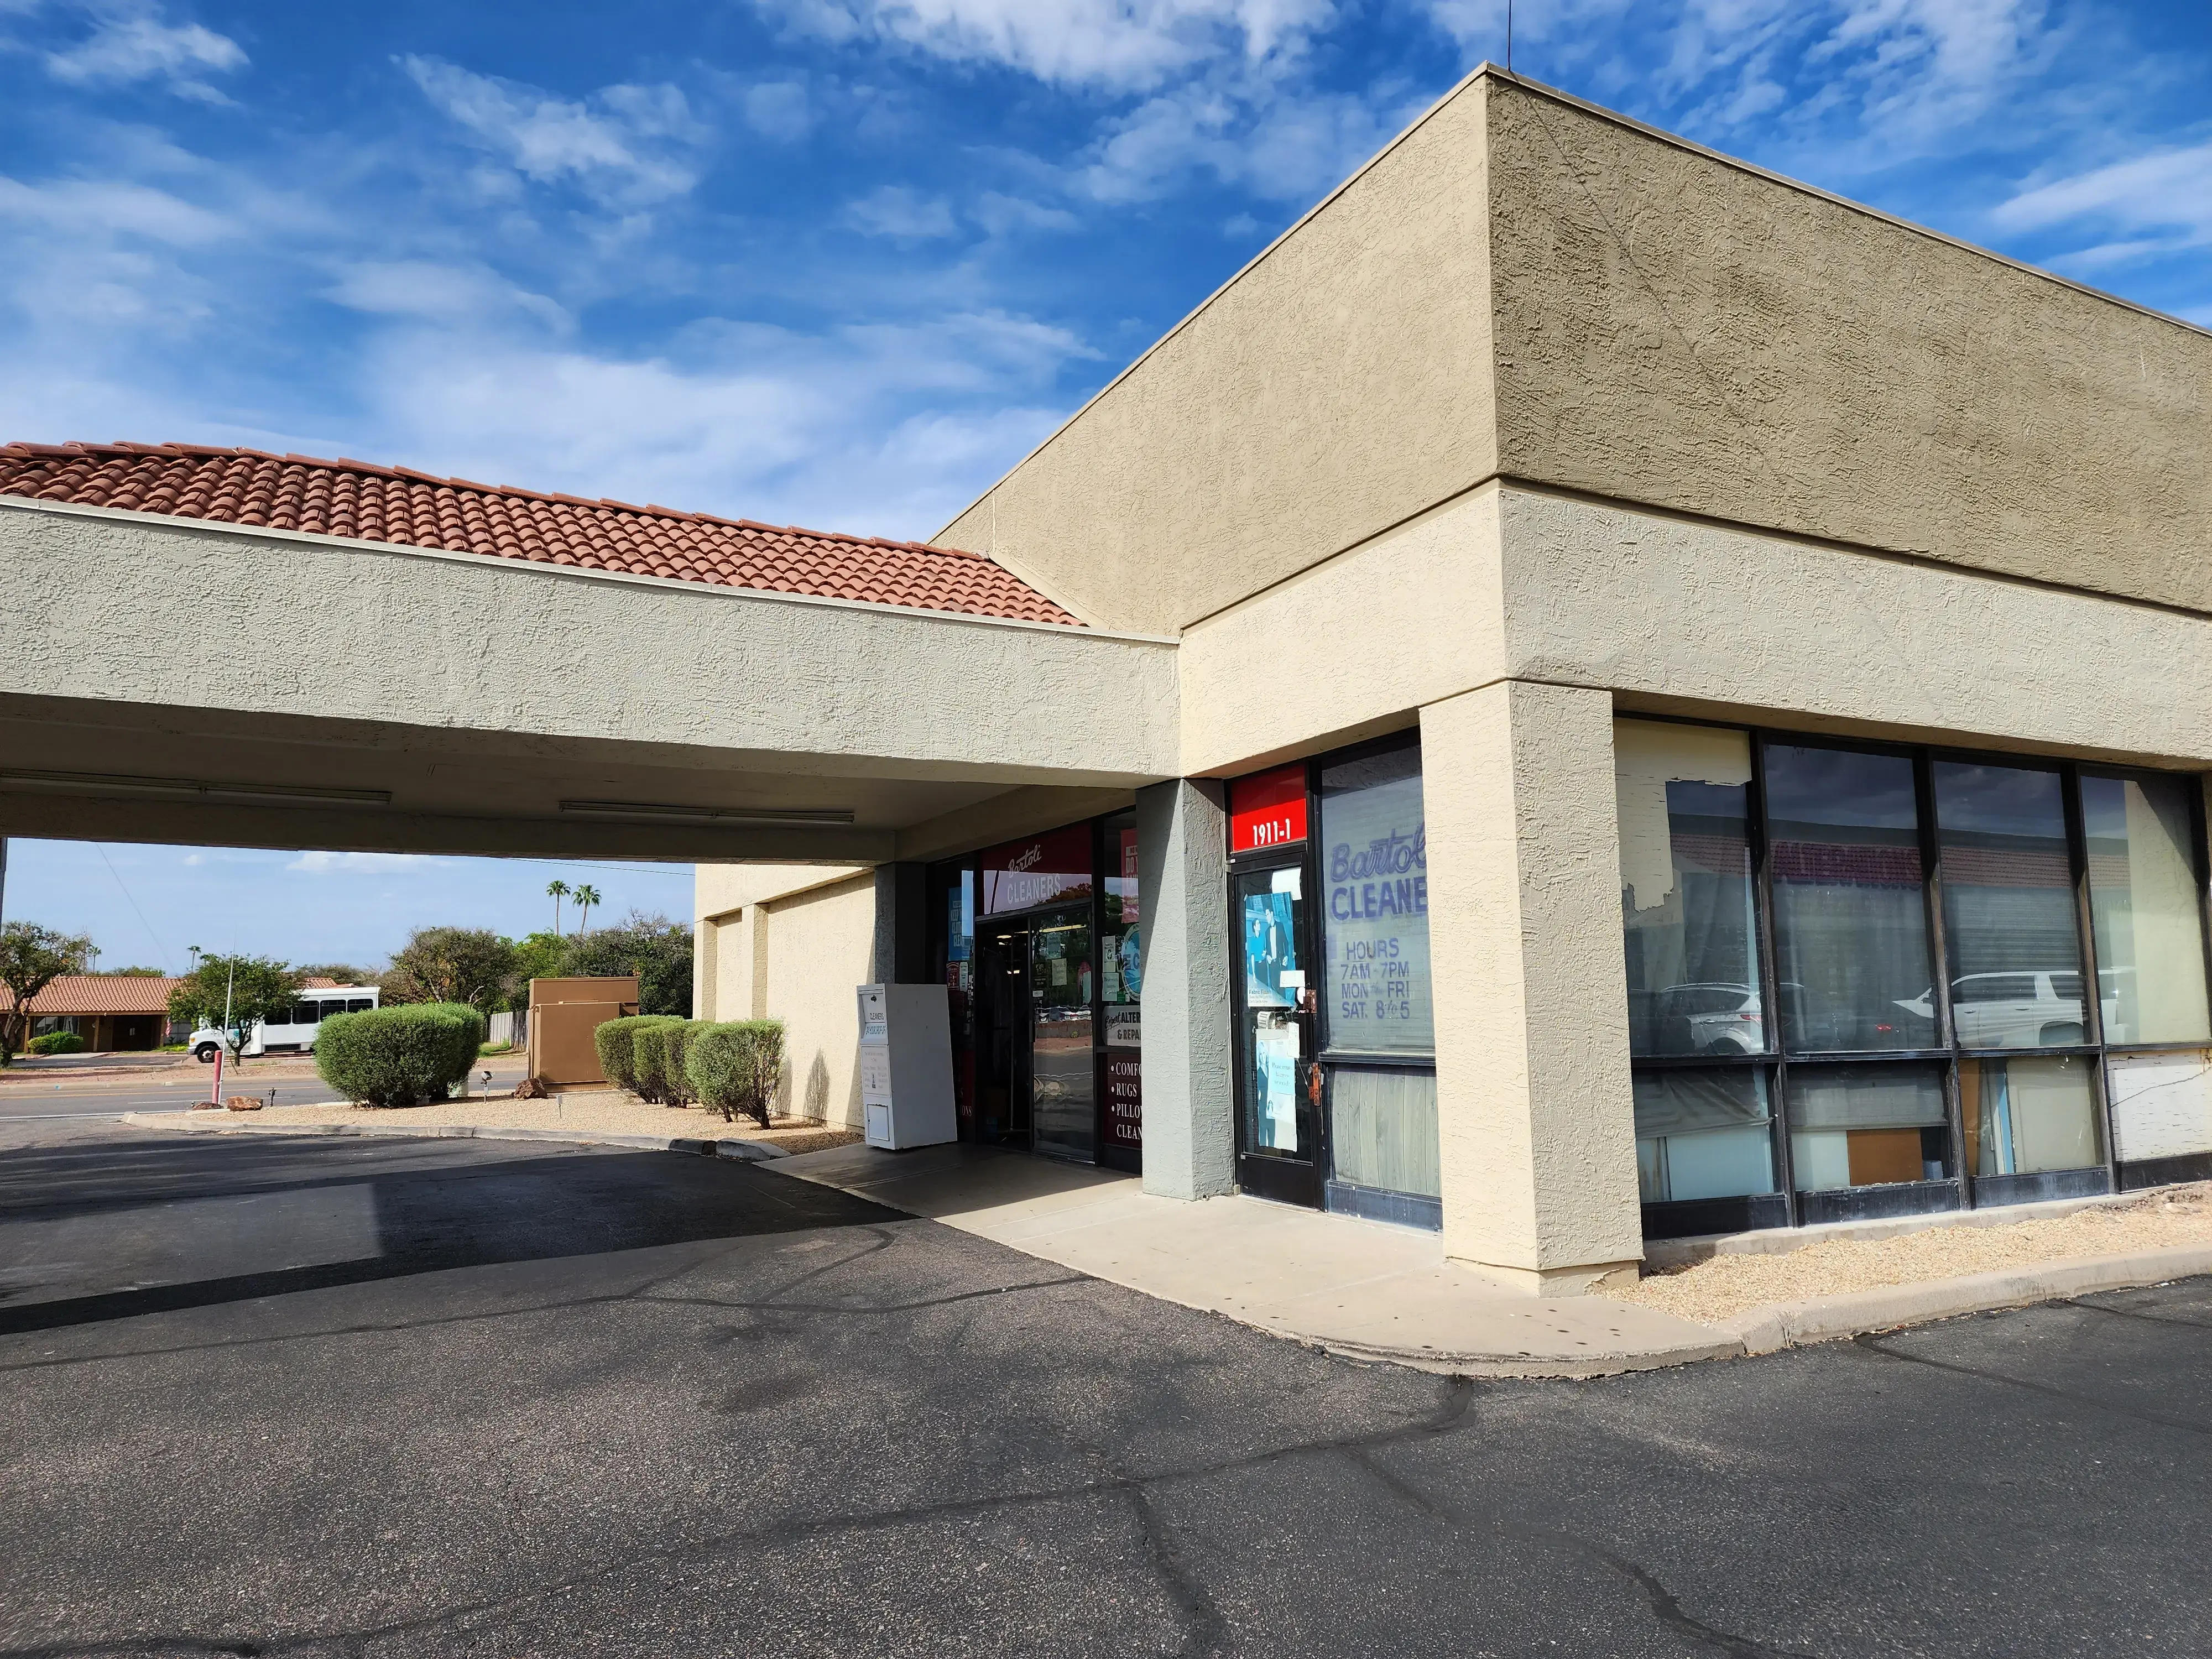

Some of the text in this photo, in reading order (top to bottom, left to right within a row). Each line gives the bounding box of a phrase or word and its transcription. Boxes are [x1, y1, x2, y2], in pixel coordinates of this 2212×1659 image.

[1253, 818, 1290, 846] 1911-1
[1008, 844, 1042, 879] Bartoli
[1008, 873, 1061, 904] CLEANERS
[1346, 937, 1400, 960] HOURS
[1340, 963, 1371, 980] 7AM
[1380, 961, 1410, 978] 7PM
[1342, 983, 1369, 999] MON
[1387, 981, 1410, 998] FRI
[1376, 1000, 1385, 1019] 8
[1400, 1001, 1410, 1019] 5
[1117, 1083, 1137, 1097] RUGS
[1117, 1103, 1142, 1118] PILLO
